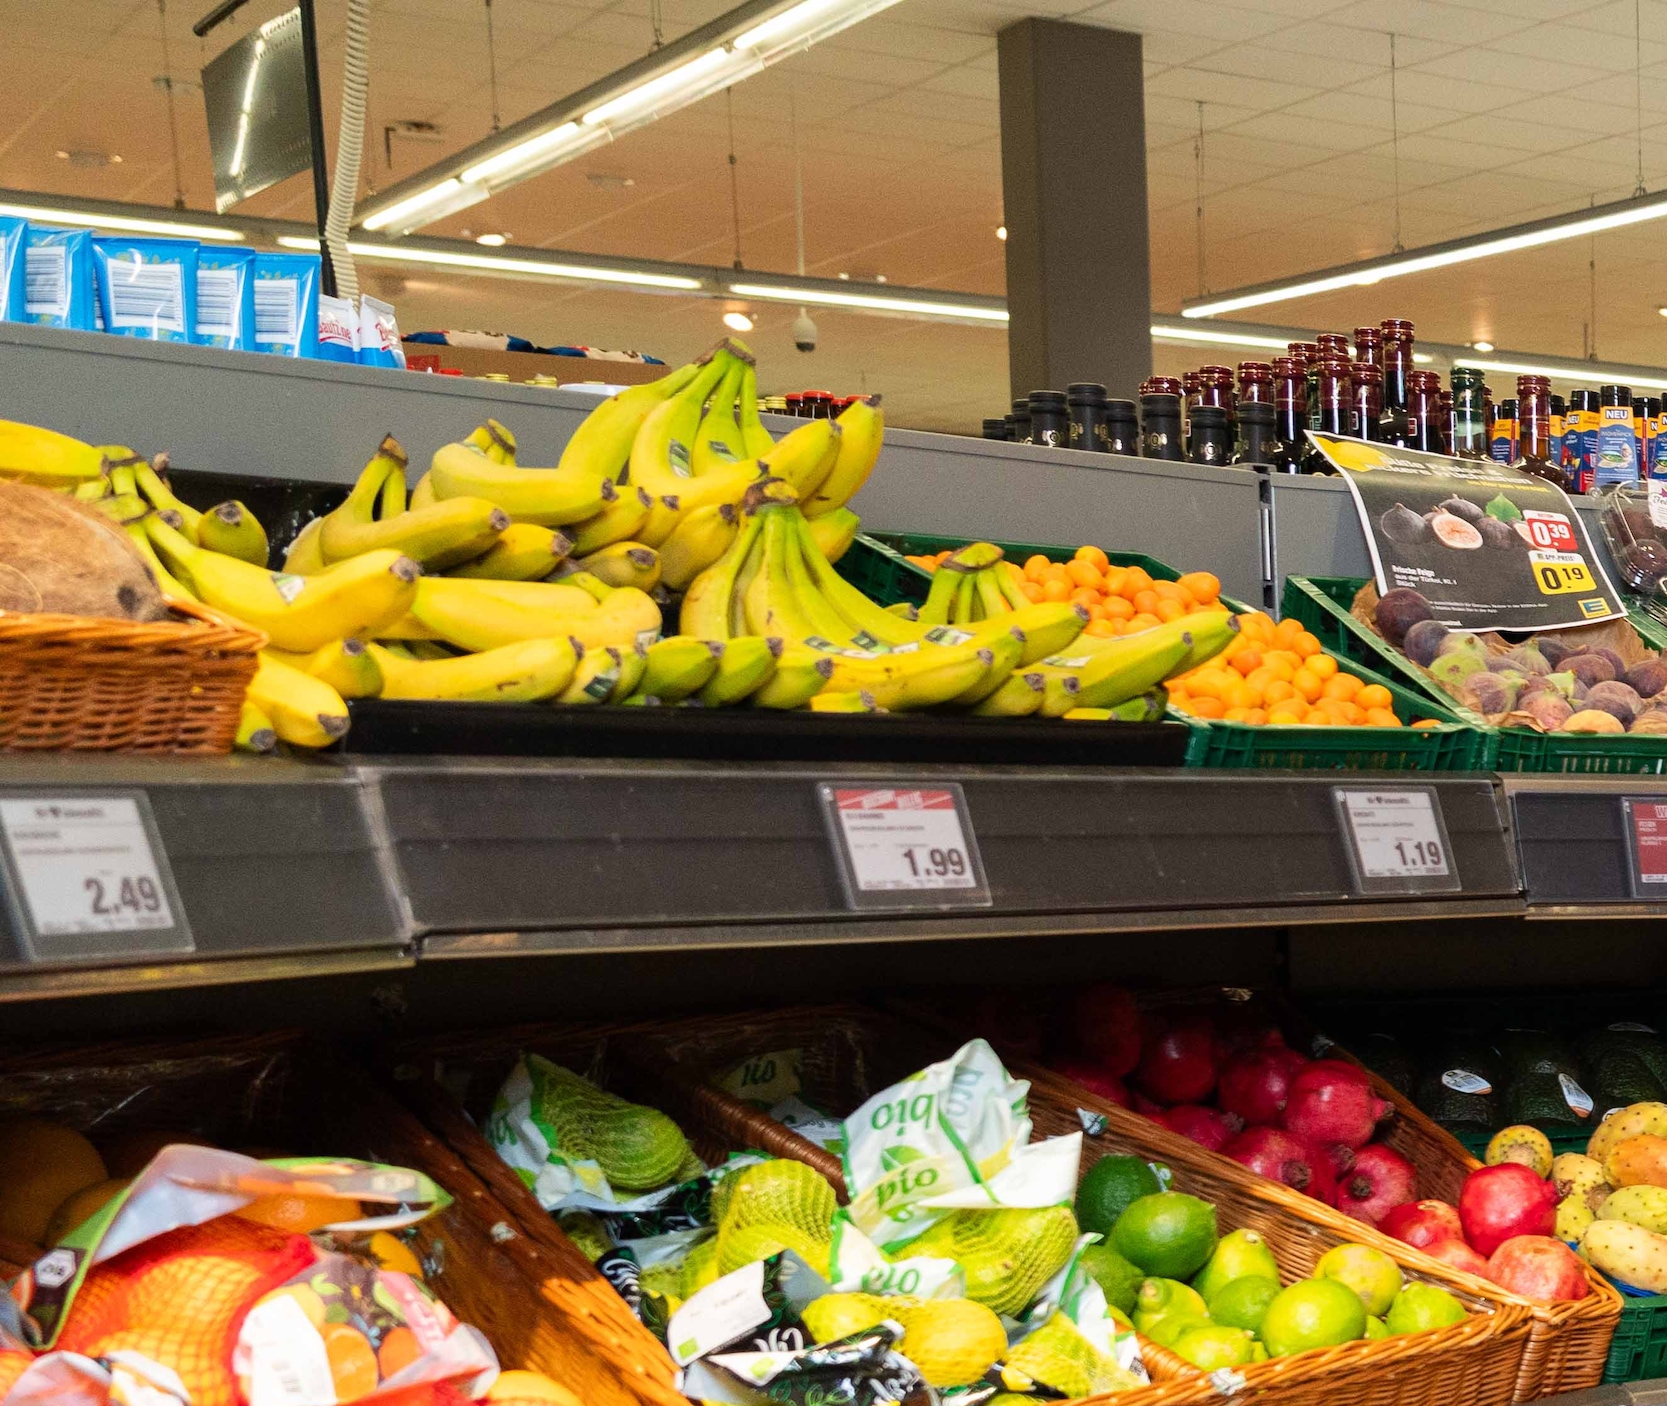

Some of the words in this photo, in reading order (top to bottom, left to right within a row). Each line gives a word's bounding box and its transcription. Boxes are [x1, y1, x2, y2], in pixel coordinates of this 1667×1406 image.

[1605, 409, 1628, 420] NEU
[904, 848, 968, 876] 1.99
[1396, 841, 1442, 866] 1.19
[85, 876, 158, 917] 2.49
[871, 1093, 936, 1137] bio
[876, 1166, 940, 1208] bio
